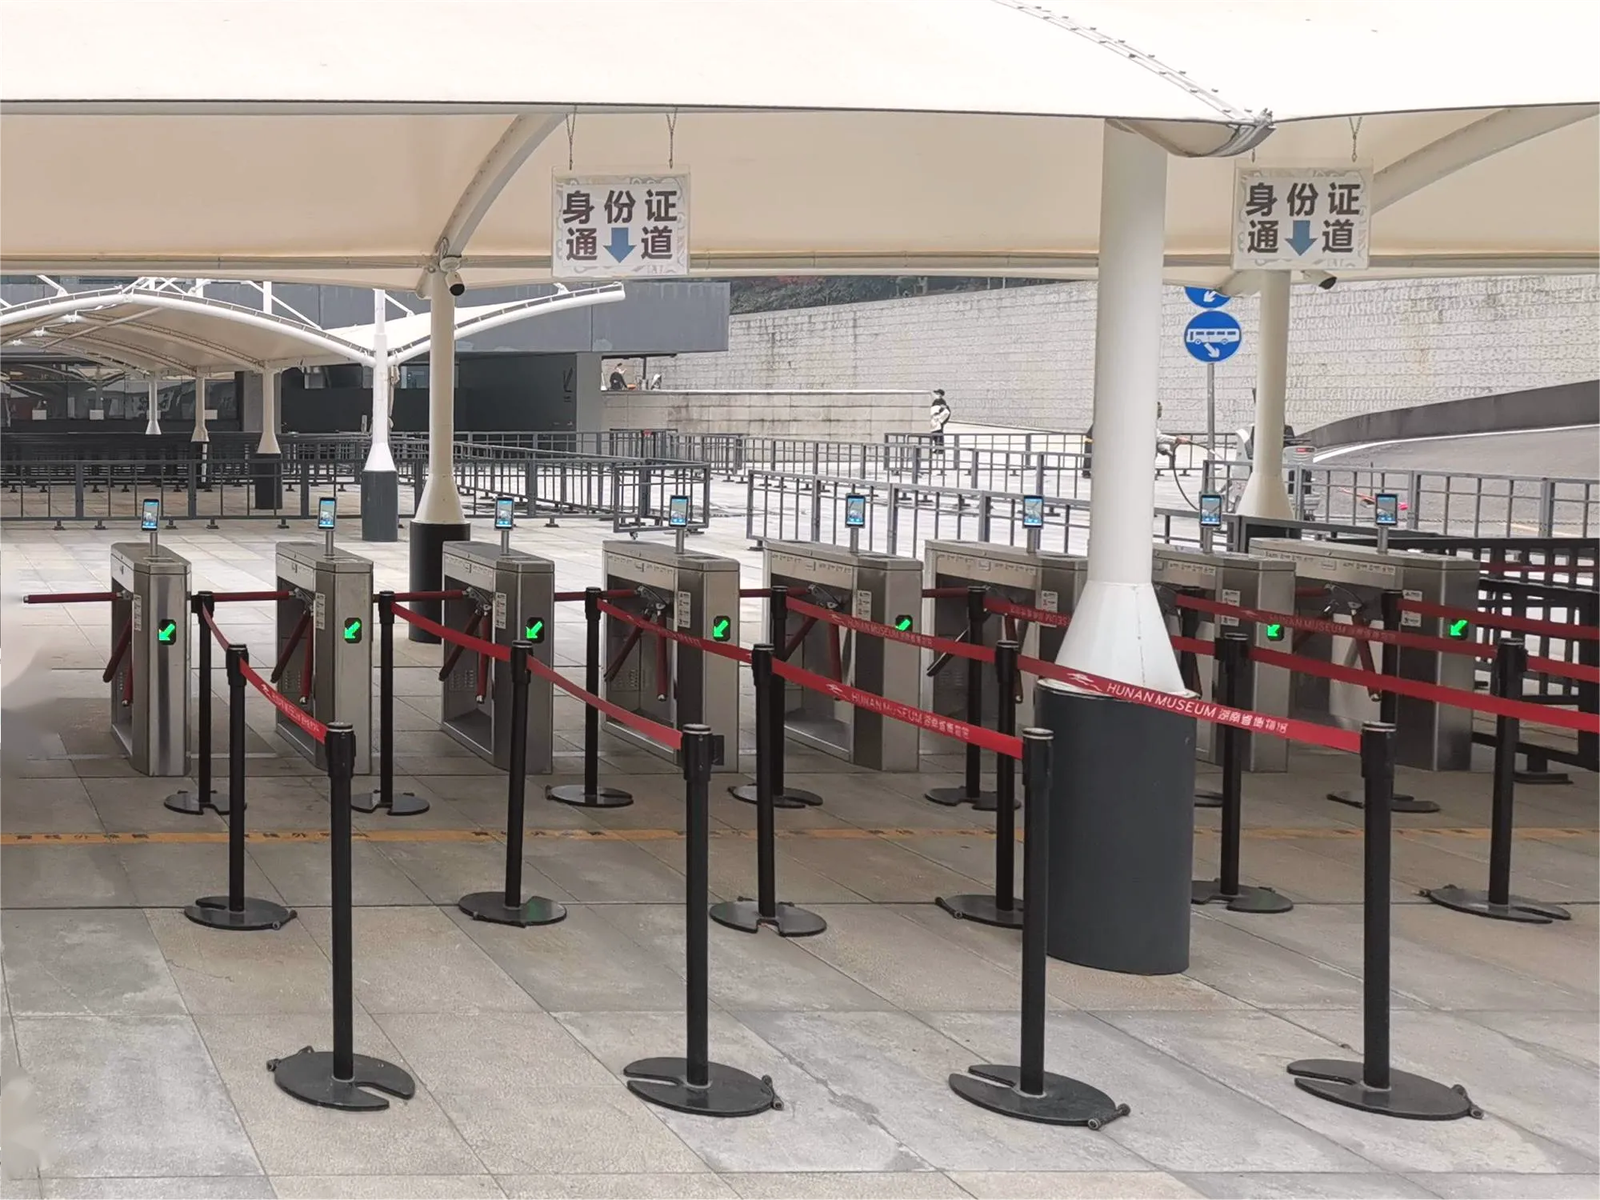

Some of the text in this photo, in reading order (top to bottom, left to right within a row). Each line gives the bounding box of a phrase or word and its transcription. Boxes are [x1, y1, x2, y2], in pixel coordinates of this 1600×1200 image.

[562, 189, 678, 224] 身份证
[1245, 182, 1361, 217] 身份证
[566, 225, 673, 261] 通道
[1247, 219, 1354, 253] 通道
[1106, 683, 1154, 703] HUNAN
[1154, 694, 1217, 718] MUSEUM
